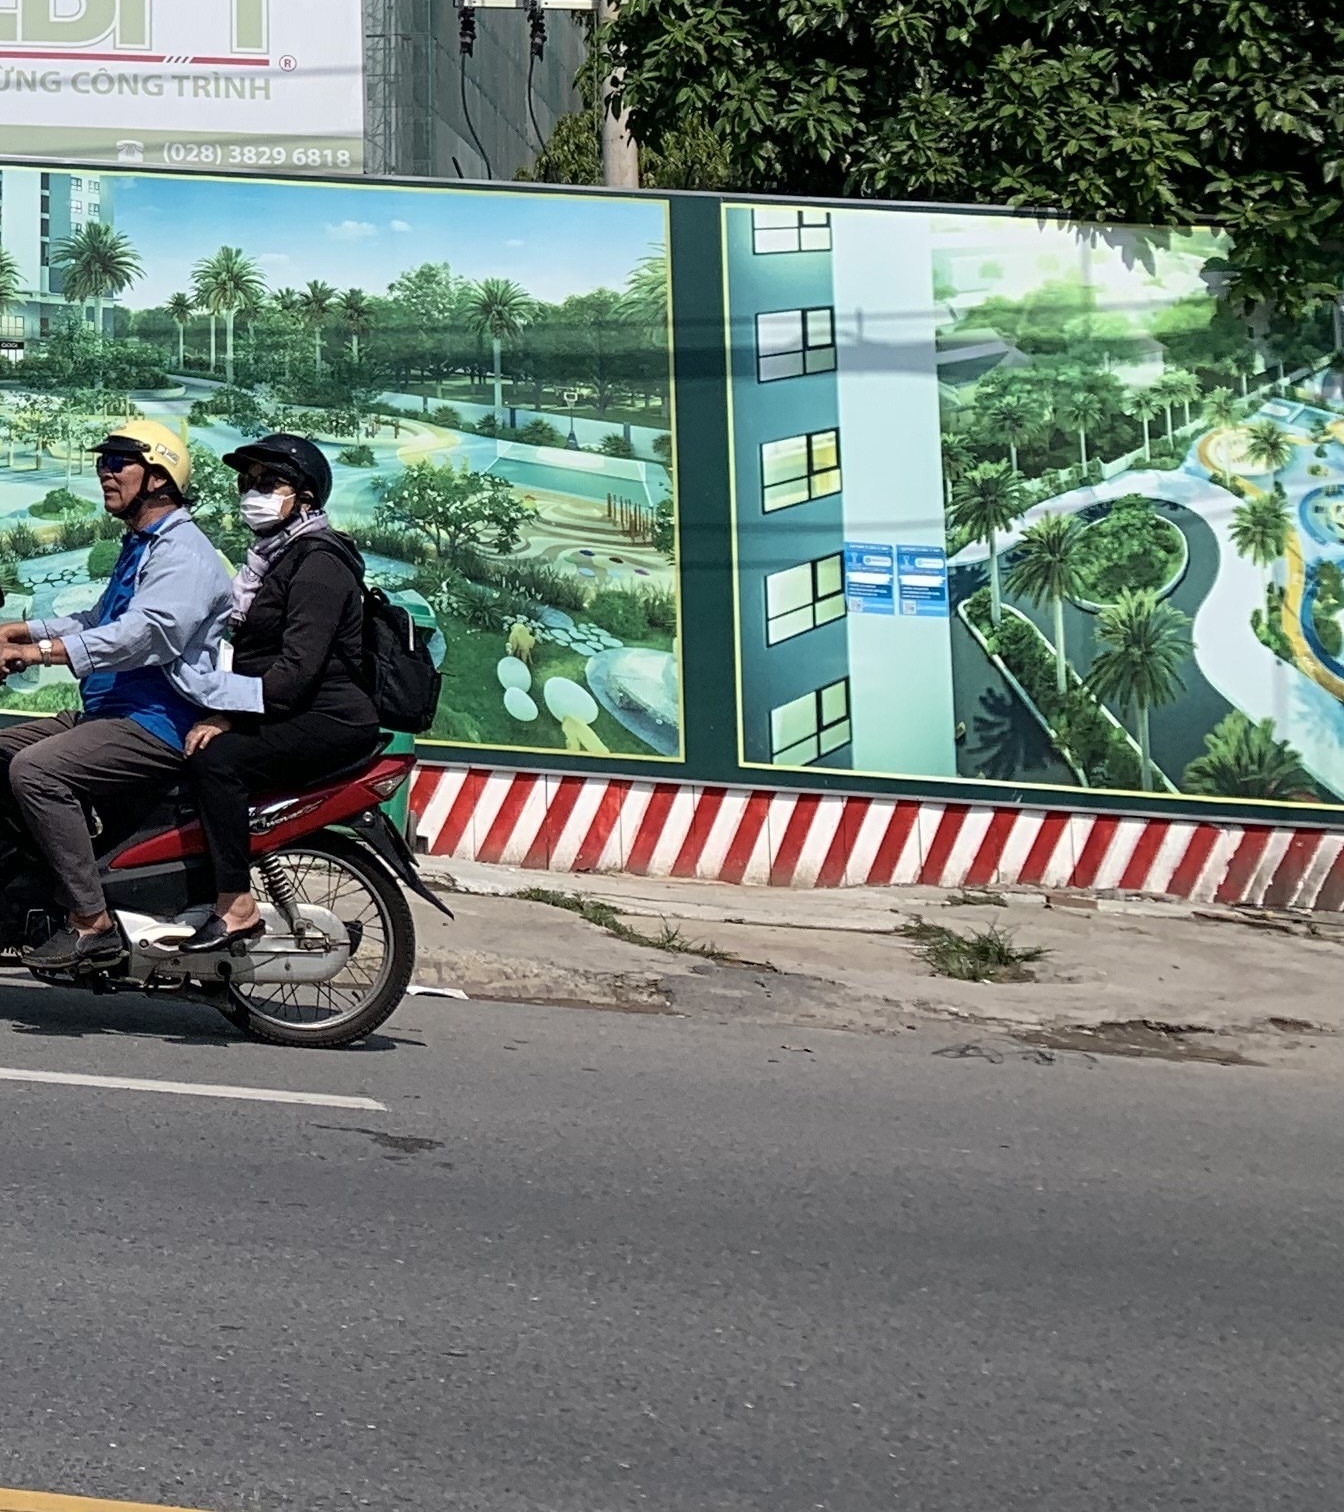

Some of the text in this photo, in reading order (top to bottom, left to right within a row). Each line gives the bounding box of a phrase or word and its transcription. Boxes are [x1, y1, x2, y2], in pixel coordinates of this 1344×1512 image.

[69, 64, 165, 98] CÔNG
[169, 70, 273, 101] TRÌNH
[162, 141, 222, 165] (028)
[227, 143, 284, 167] 3829
[292, 146, 352, 170] 6818
